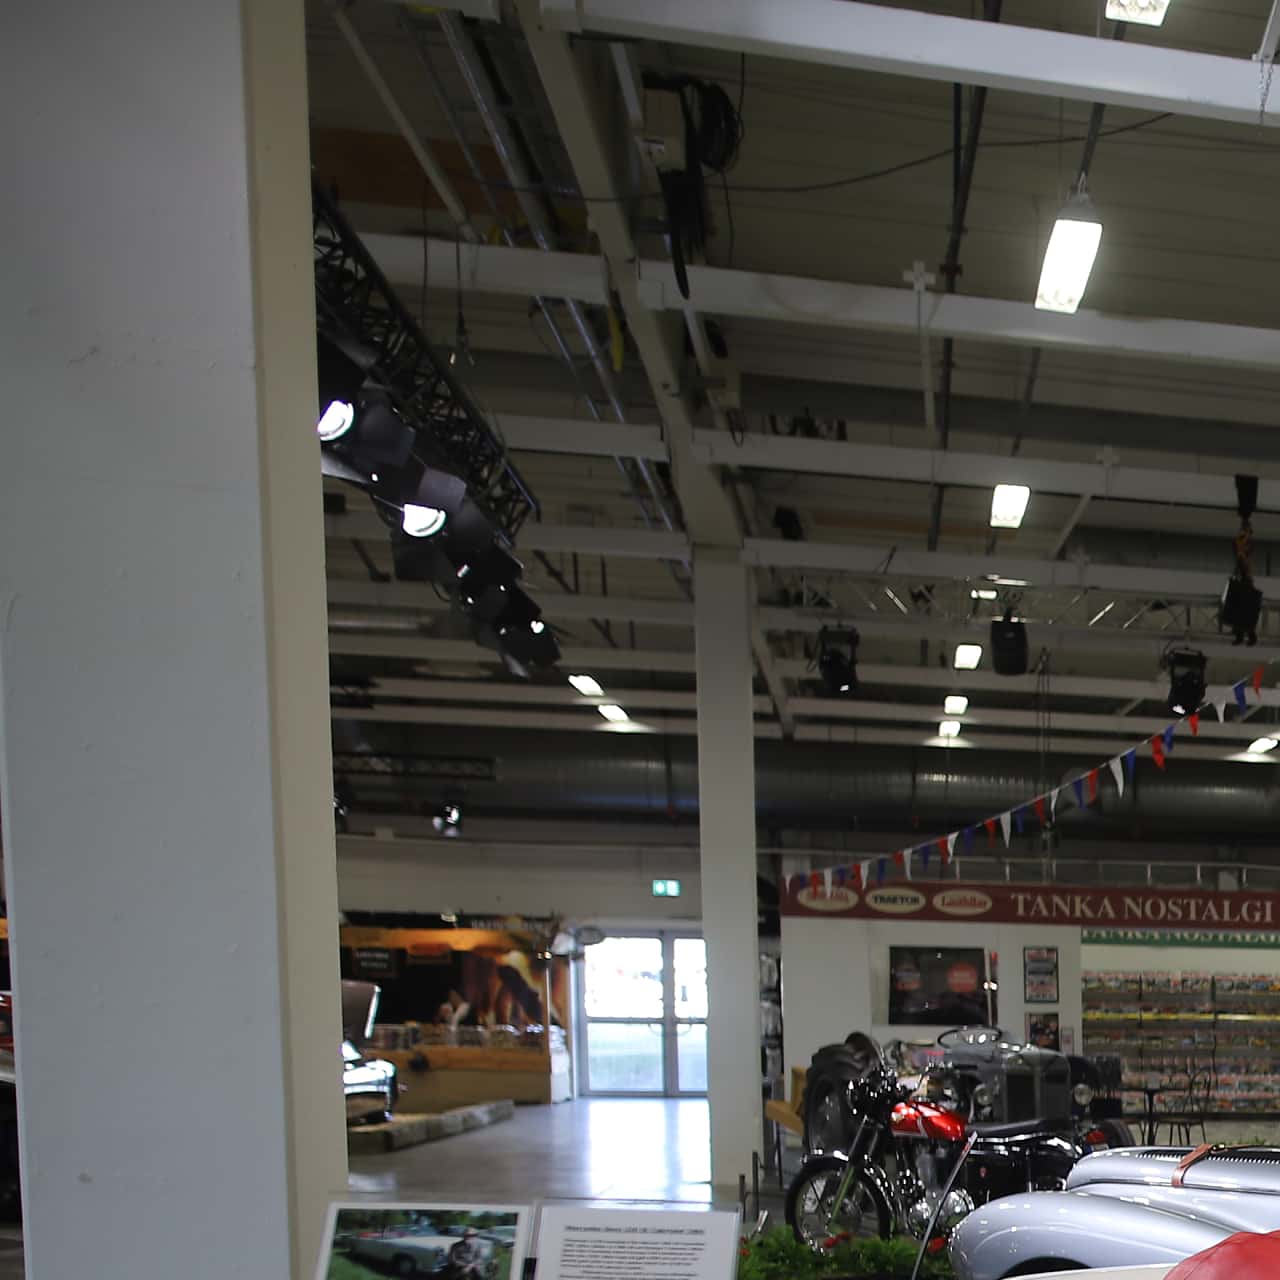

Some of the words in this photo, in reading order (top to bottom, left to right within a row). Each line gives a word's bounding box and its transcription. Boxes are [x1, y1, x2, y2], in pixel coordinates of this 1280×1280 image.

[873, 894, 920, 905] TRAKTOR
[1010, 892, 1116, 919] TANKA
[1124, 896, 1274, 923] NOSTALGI
